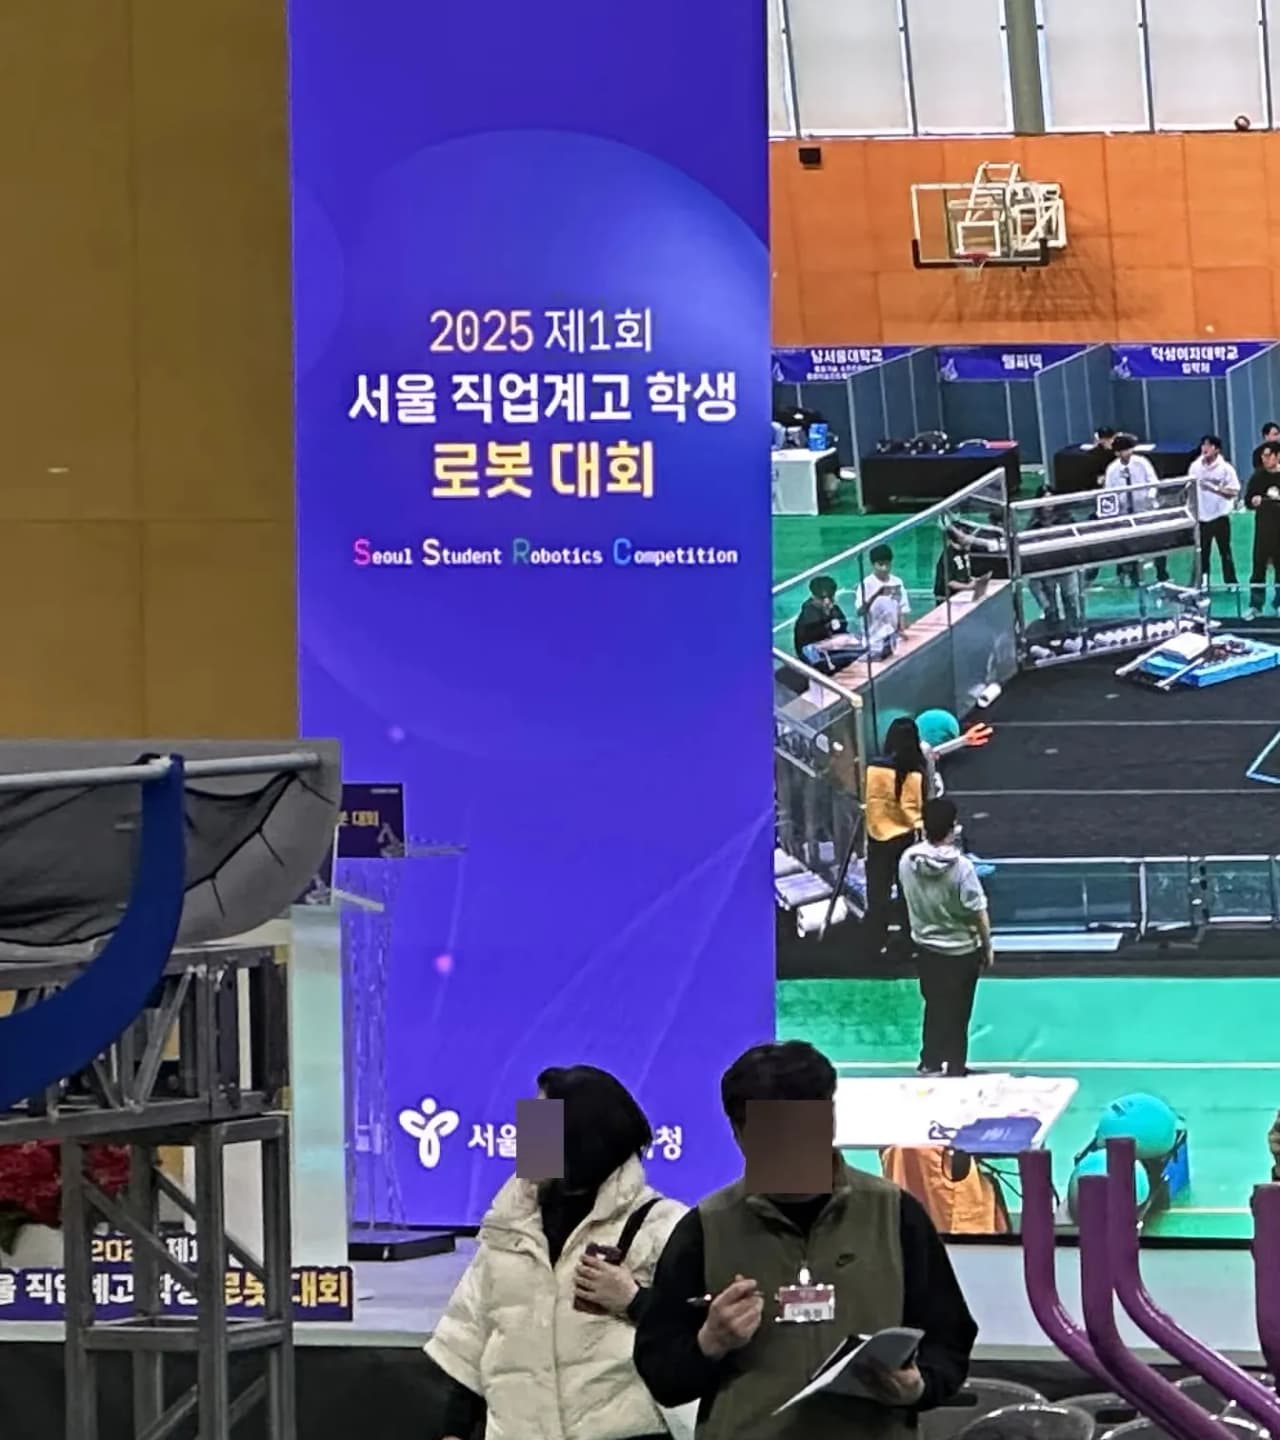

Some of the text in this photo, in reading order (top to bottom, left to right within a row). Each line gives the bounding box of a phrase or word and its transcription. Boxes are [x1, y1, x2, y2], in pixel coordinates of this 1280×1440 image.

[430, 308, 652, 354] 2025 제1회
[348, 371, 737, 423] 서울 직업계고 학생
[431, 440, 655, 499] 로봇 대회
[353, 538, 738, 567] Seoul Student Robotics Competition
